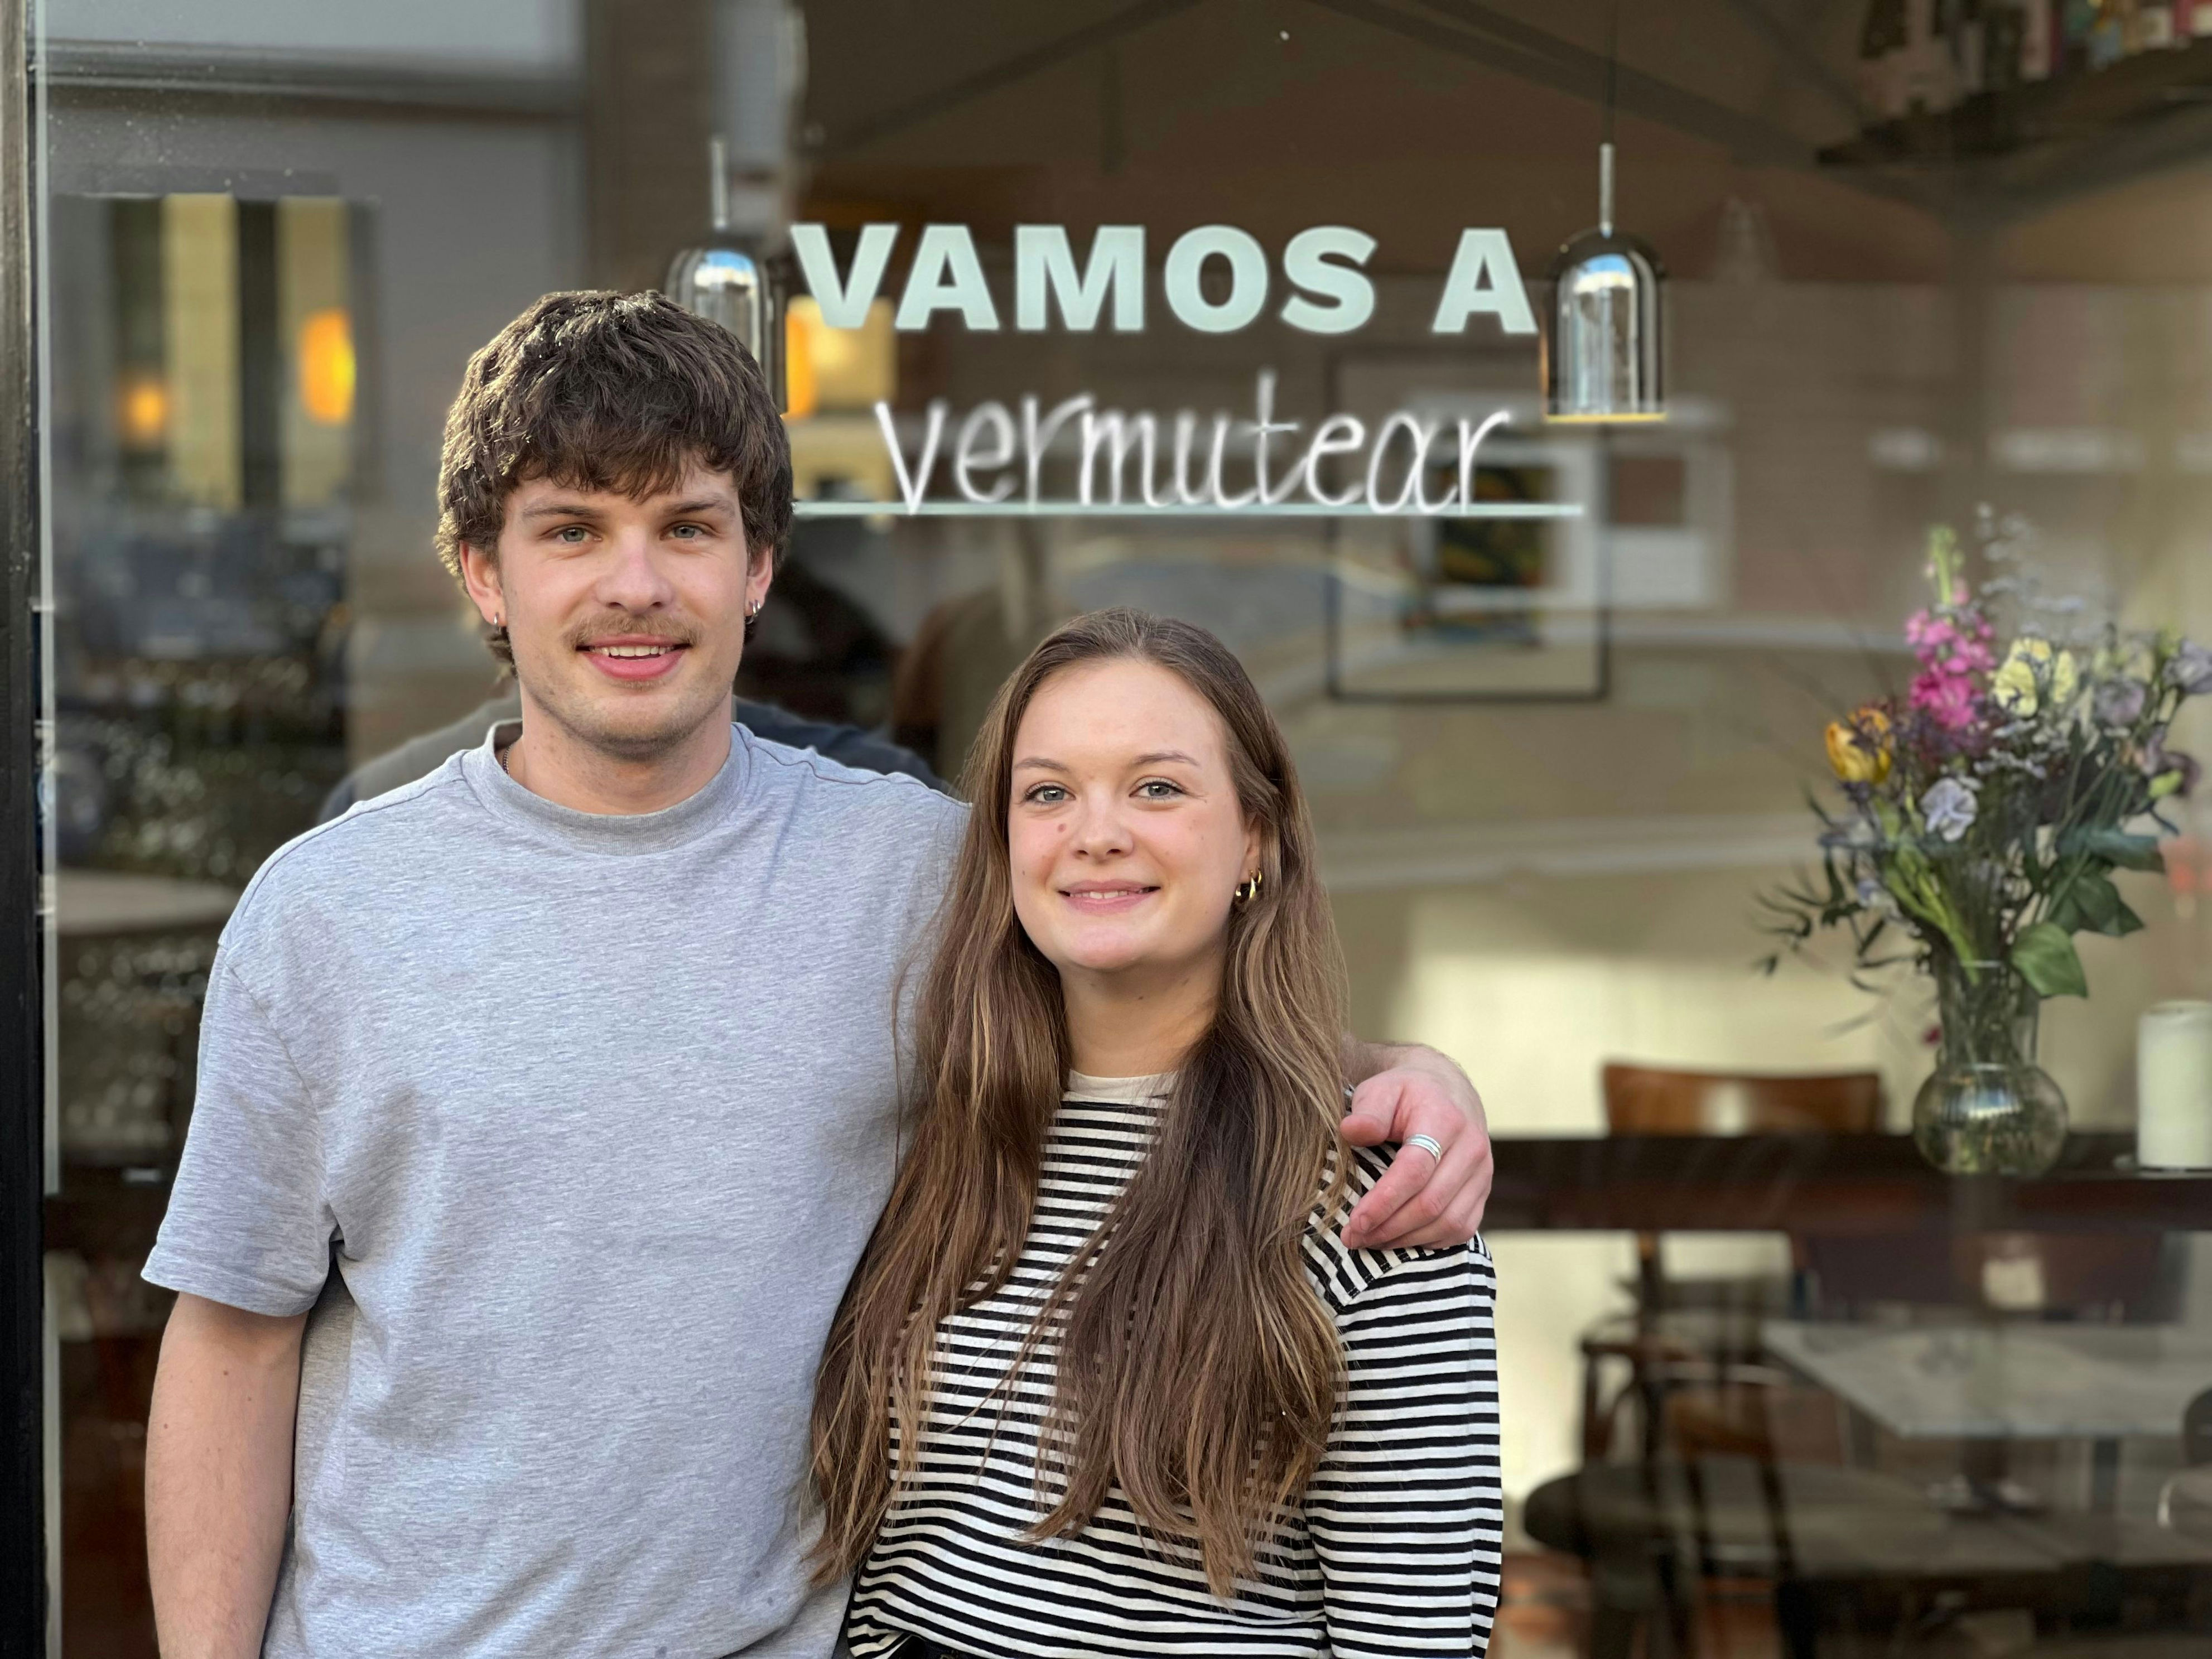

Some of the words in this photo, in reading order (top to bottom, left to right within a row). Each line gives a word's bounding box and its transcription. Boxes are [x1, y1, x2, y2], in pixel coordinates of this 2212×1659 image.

[791, 225, 1378, 334] VAMOS
[1432, 228, 1539, 334] A
[875, 368, 1512, 515] vermutear
